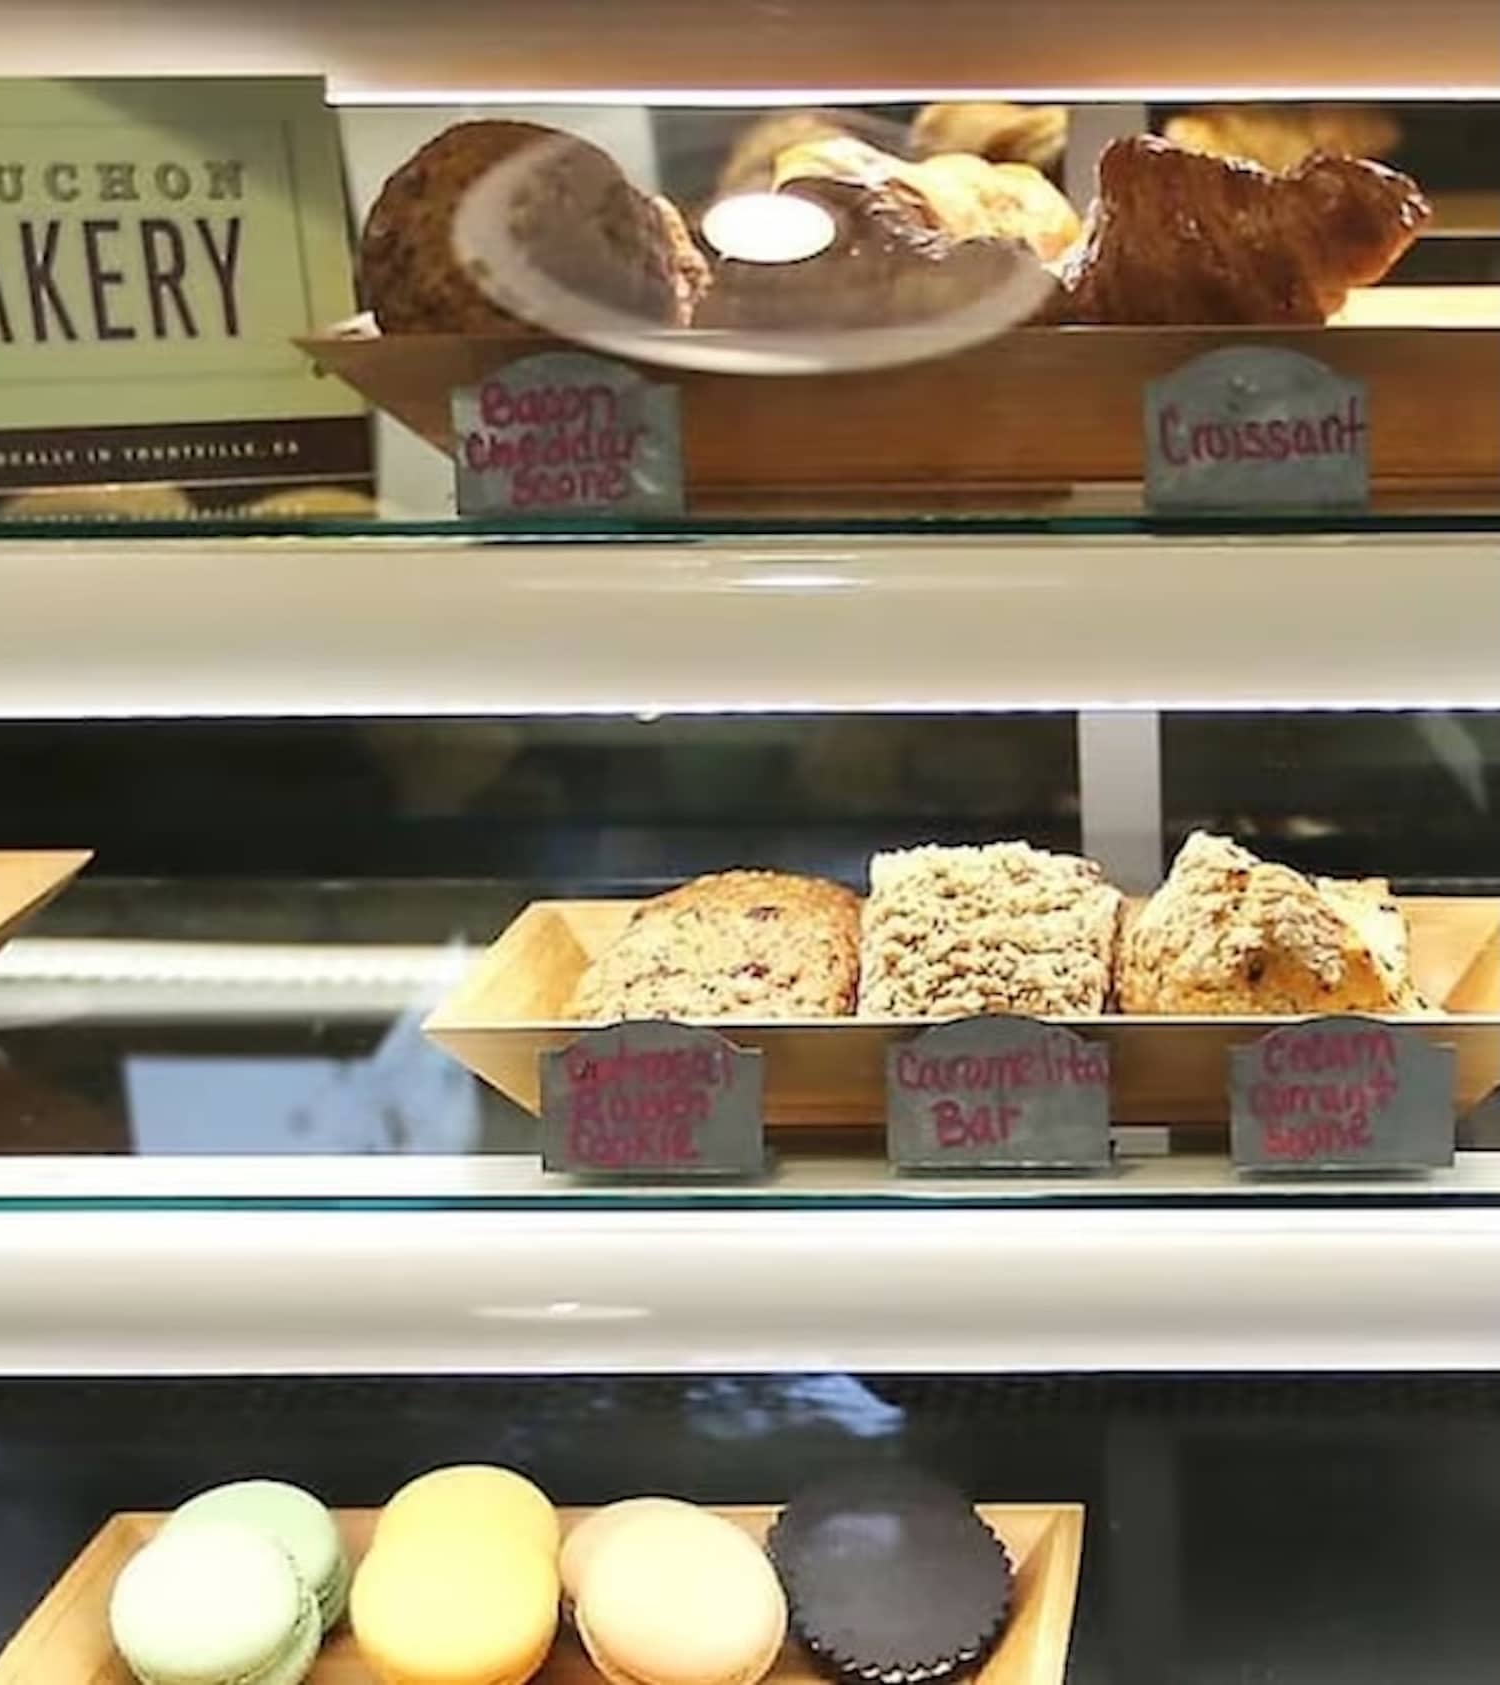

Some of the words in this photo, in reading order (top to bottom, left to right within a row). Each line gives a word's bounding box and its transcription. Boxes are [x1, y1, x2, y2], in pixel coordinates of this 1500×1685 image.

[481, 381, 617, 428] Bacon
[87, 448, 112, 463] IN
[1158, 397, 1367, 466] Croissant
[898, 1030, 1111, 1090] Caramelita
[931, 1098, 1022, 1148] Bar
